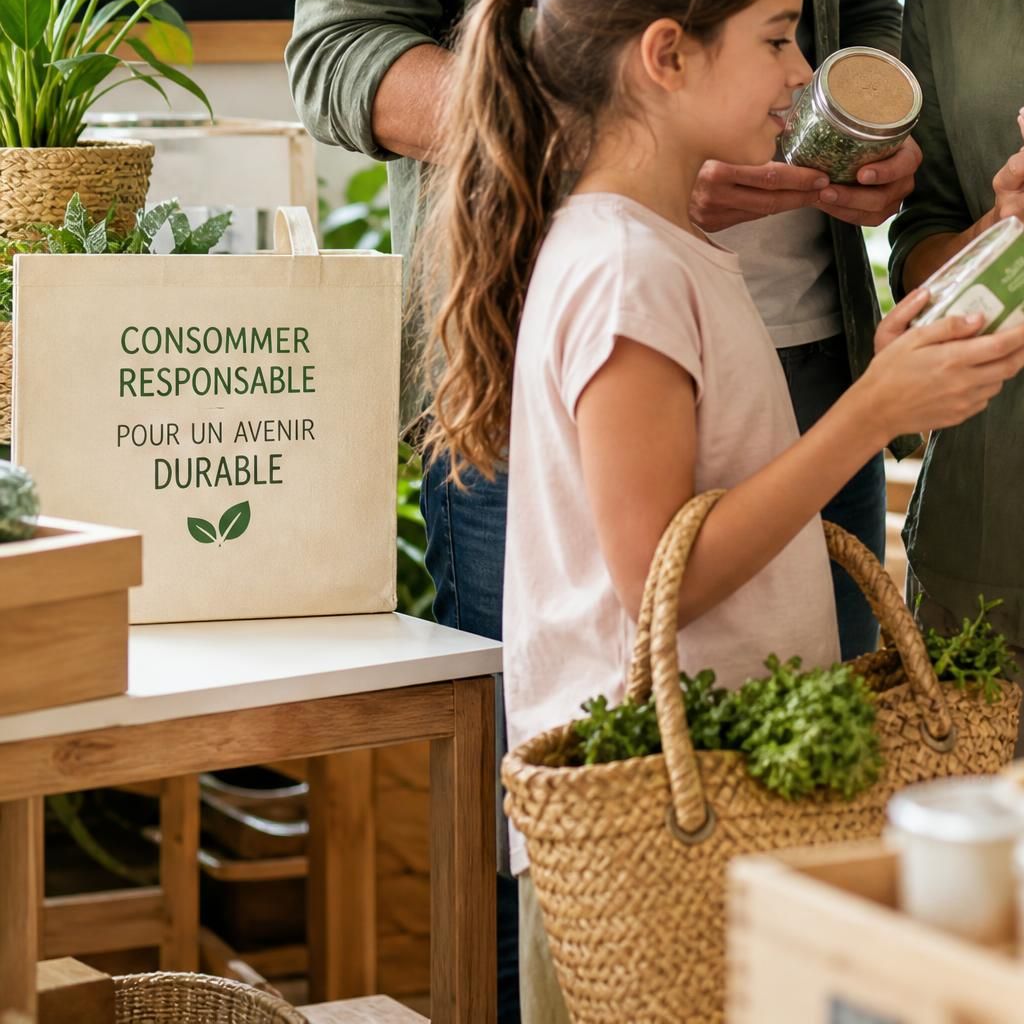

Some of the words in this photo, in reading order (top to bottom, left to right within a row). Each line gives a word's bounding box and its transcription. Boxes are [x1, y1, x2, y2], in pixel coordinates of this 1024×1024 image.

[120, 325, 311, 355] CONSOMMER
[119, 365, 316, 398] RESPONSABLE
[117, 422, 180, 448] POUR
[191, 421, 223, 445] UN
[233, 418, 316, 444] AVENIR
[154, 453, 284, 490] DURABLE
